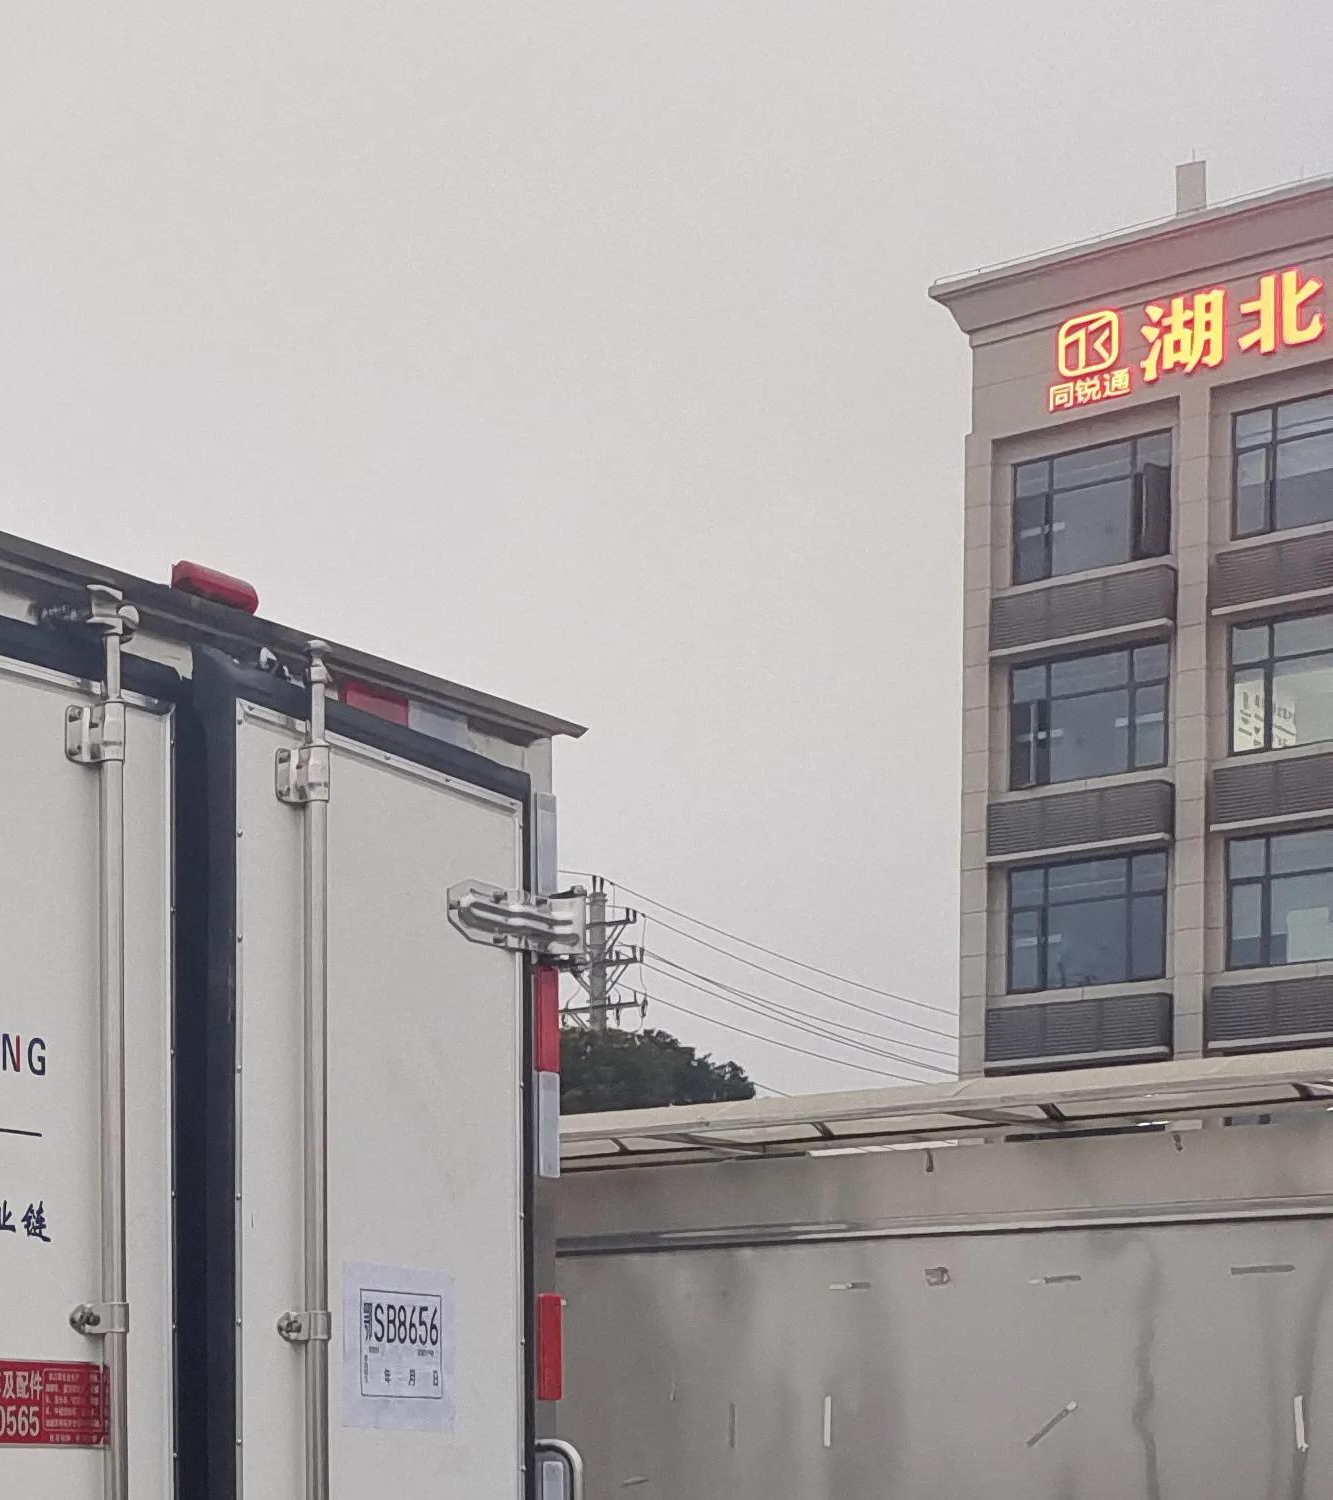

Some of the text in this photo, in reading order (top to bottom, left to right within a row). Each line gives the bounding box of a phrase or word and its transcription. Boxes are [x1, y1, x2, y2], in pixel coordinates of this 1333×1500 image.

[1140, 267, 1325, 382] 湖北
[1048, 367, 1131, 411] 同锐通
